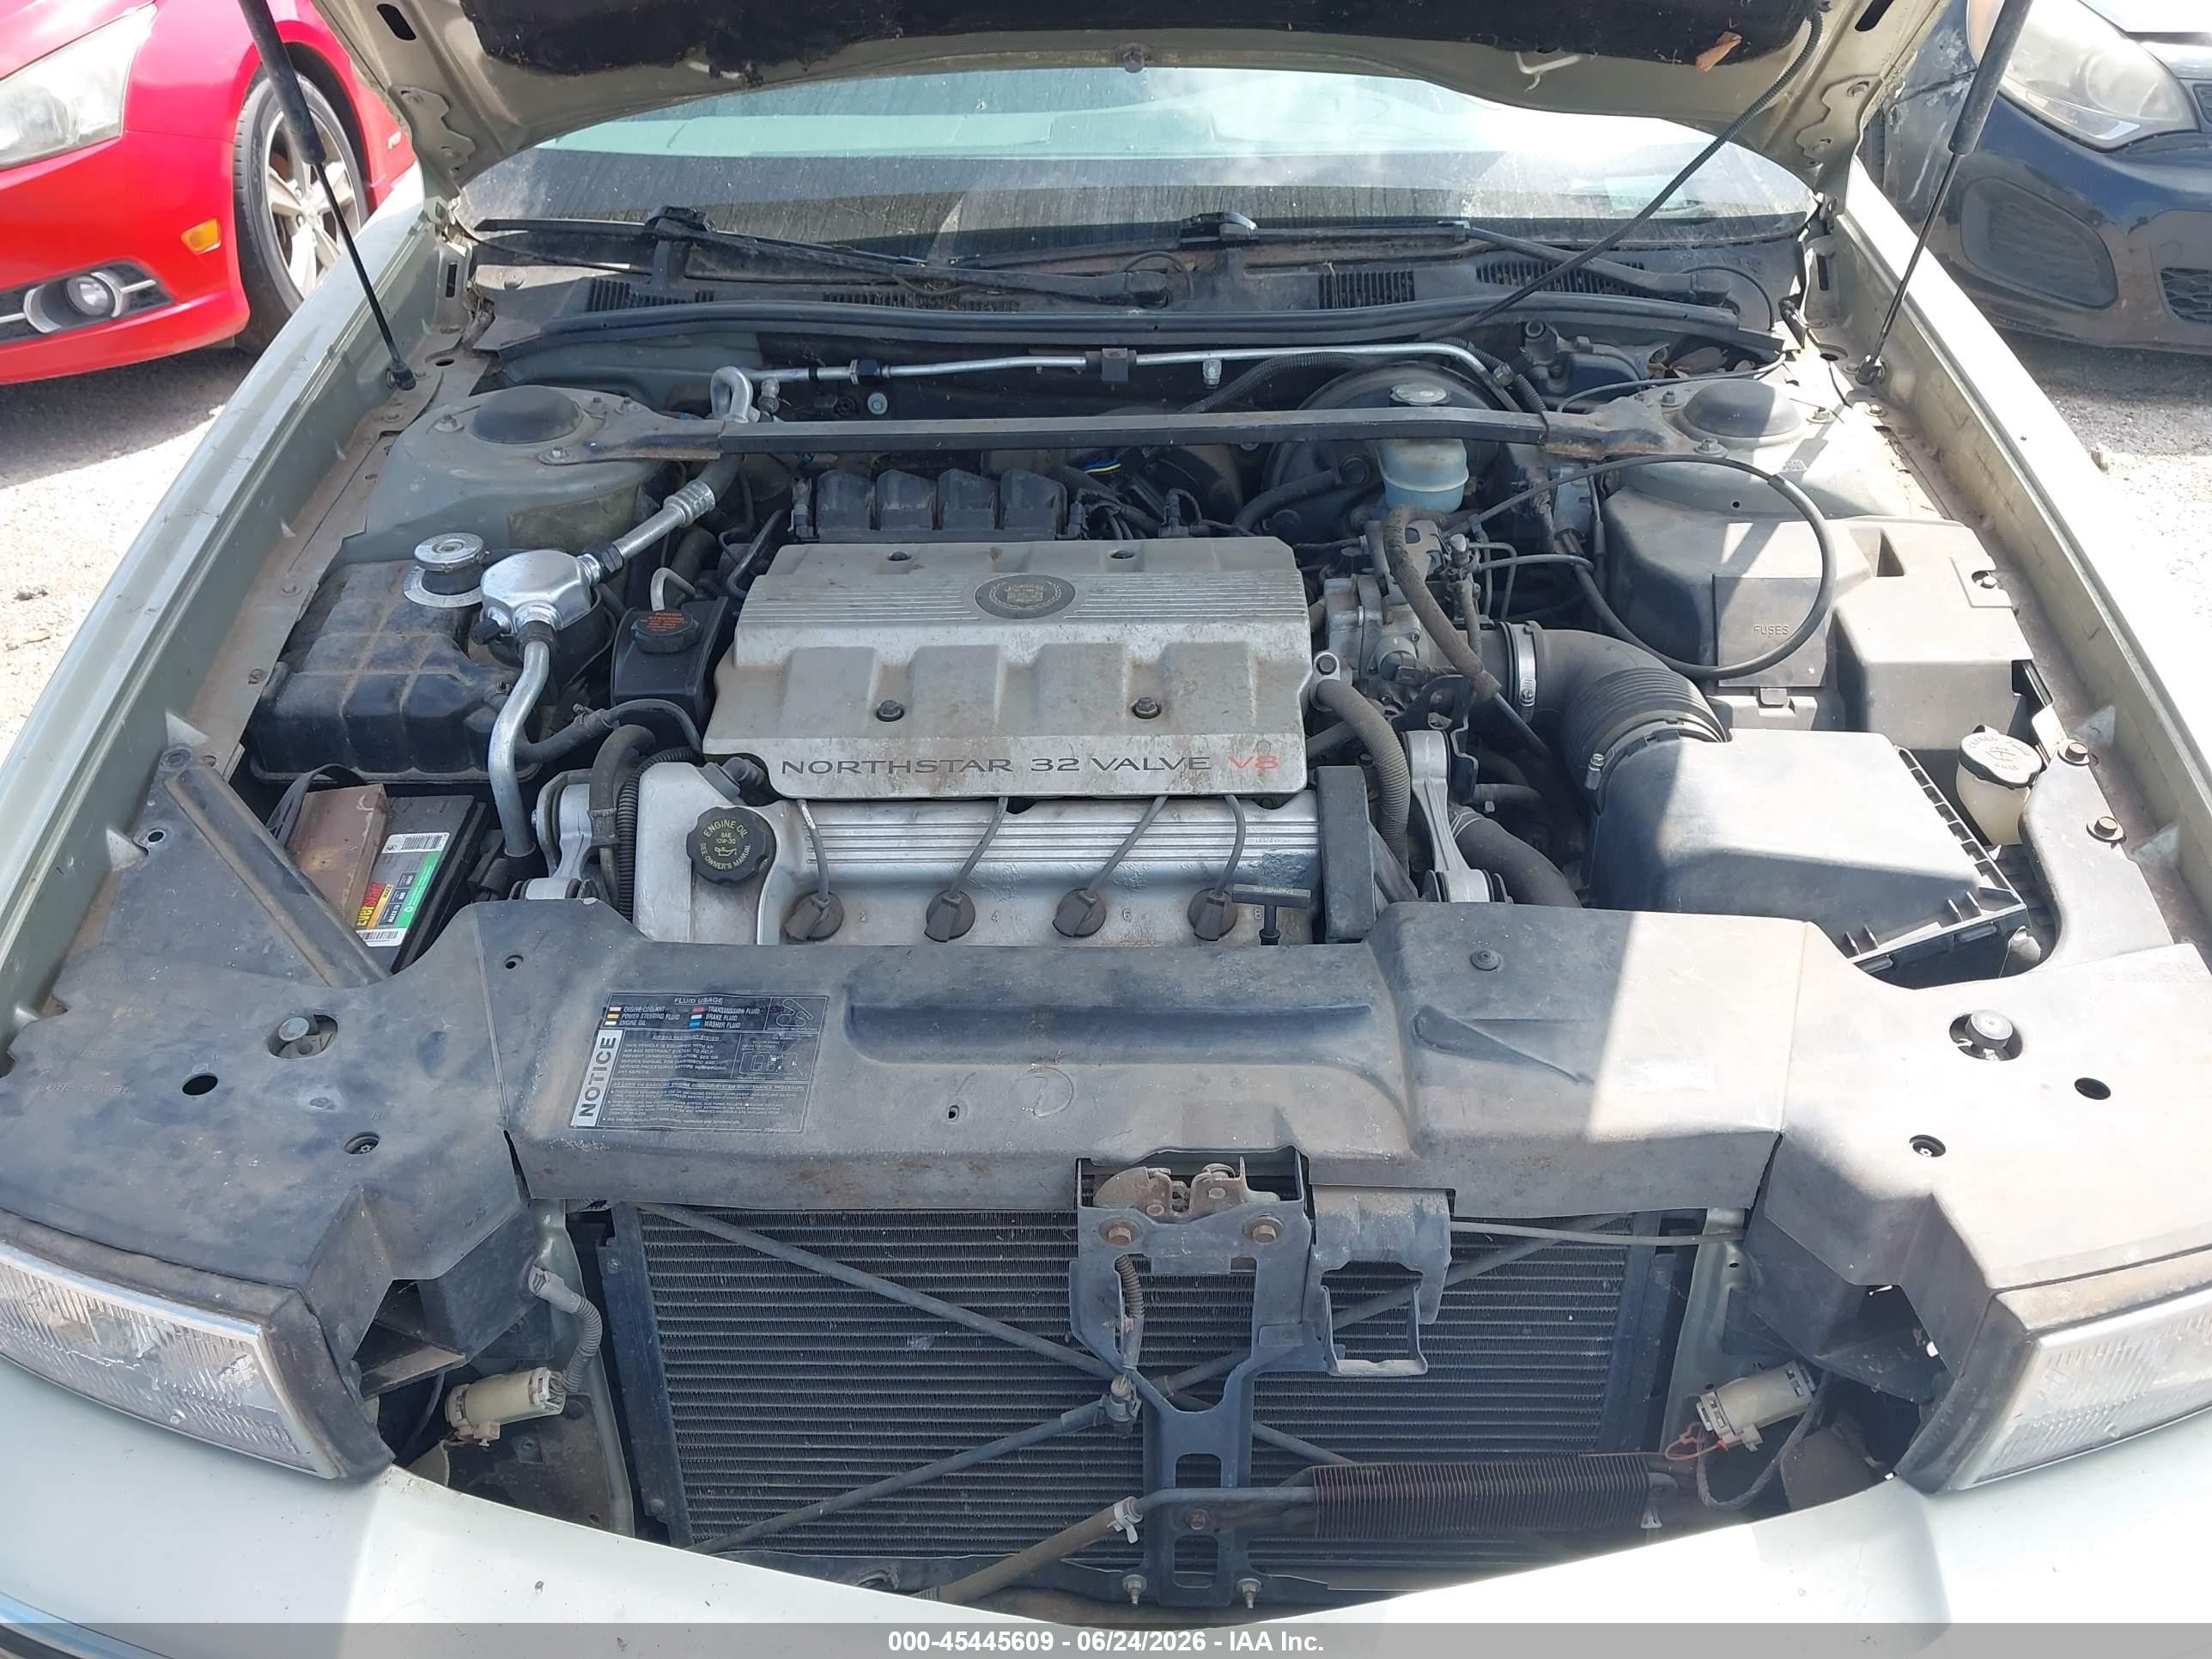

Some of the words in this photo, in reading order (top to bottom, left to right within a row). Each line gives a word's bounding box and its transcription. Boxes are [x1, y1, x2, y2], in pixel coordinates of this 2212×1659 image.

[1753, 625, 1790, 635] FUSES
[781, 758, 1013, 775] NORTHSTAR
[1030, 757, 1080, 772] 32
[1090, 756, 1211, 772] VALVE
[1226, 755, 1279, 771] V8
[702, 819, 737, 838] ENGINE
[736, 824, 749, 838] OIL
[700, 842, 708, 856] SEE
[704, 855, 732, 871] OWNER'S
[733, 844, 751, 867] MANUAL
[860, 910, 869, 921] 2
[991, 910, 1001, 922] 4
[1121, 908, 1133, 922] 6
[1253, 908, 1262, 921] 8
[704, 1020, 728, 1029] WASHER
[578, 1036, 617, 1117] NOTICE
